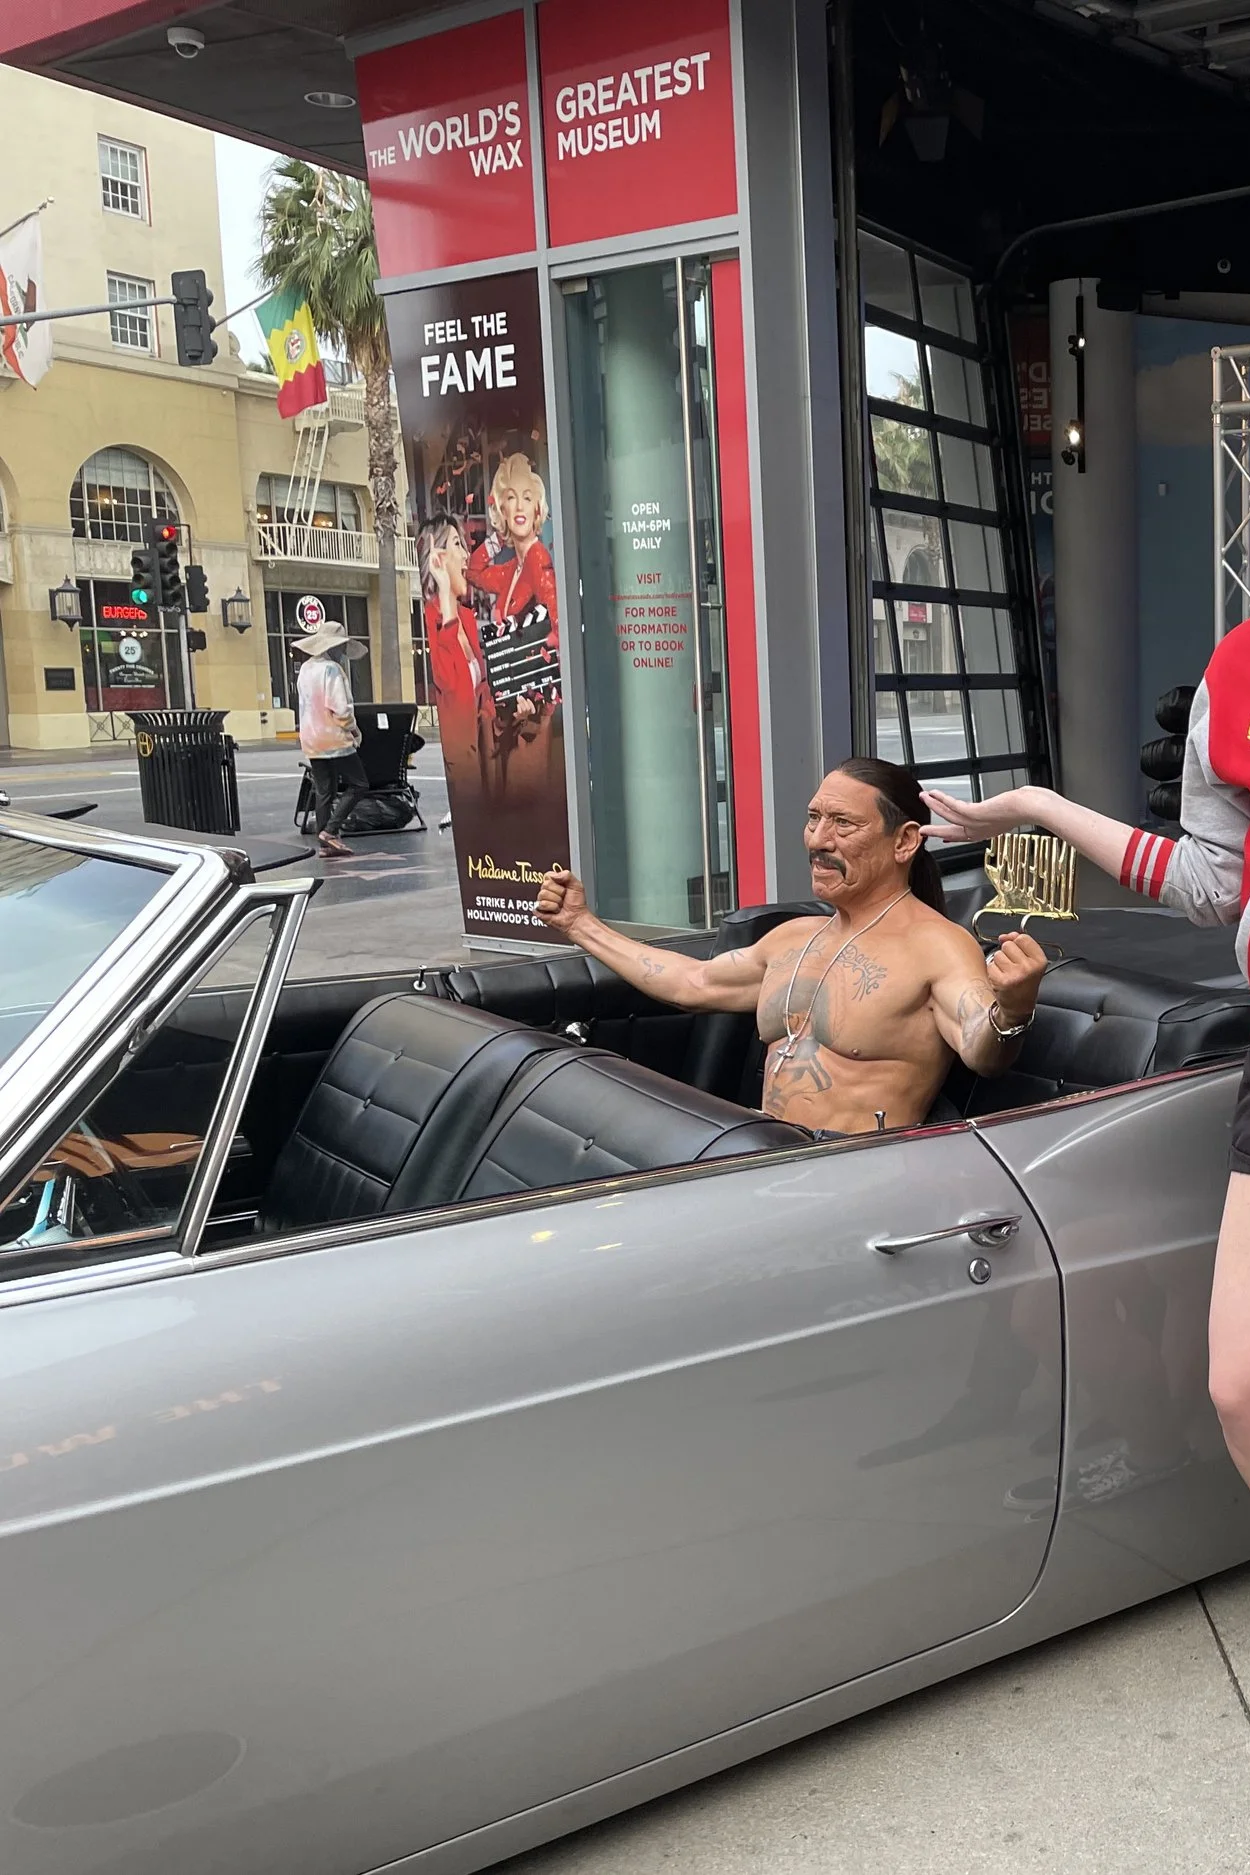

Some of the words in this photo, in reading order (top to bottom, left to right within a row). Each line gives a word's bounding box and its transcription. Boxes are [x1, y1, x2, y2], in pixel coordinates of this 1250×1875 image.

[556, 52, 711, 123] GREATEST
[369, 146, 396, 169] THE
[398, 101, 521, 161] WORLD'S
[557, 109, 661, 161] MUSEUM
[469, 139, 523, 177] WAX
[424, 319, 467, 346] FEEL
[471, 311, 508, 339] THE
[421, 344, 517, 397] FAME
[631, 502, 660, 516] OPEN
[622, 519, 671, 533] 11AM-6PM
[632, 537, 662, 550] DAILY
[636, 572, 661, 584] VISIT
[624, 607, 646, 618] FOR
[648, 606, 677, 617] MORE
[616, 623, 687, 636] INFORMATION
[621, 641, 636, 652] OR
[639, 641, 652, 651] TO
[655, 640, 684, 651] BOOK
[633, 656, 674, 668] ONLINE!
[468, 855, 521, 882] Madame
[476, 896, 506, 909] STRIKE
[507, 899, 514, 909] A
[467, 909, 530, 926] HOLLYWOOD'S
